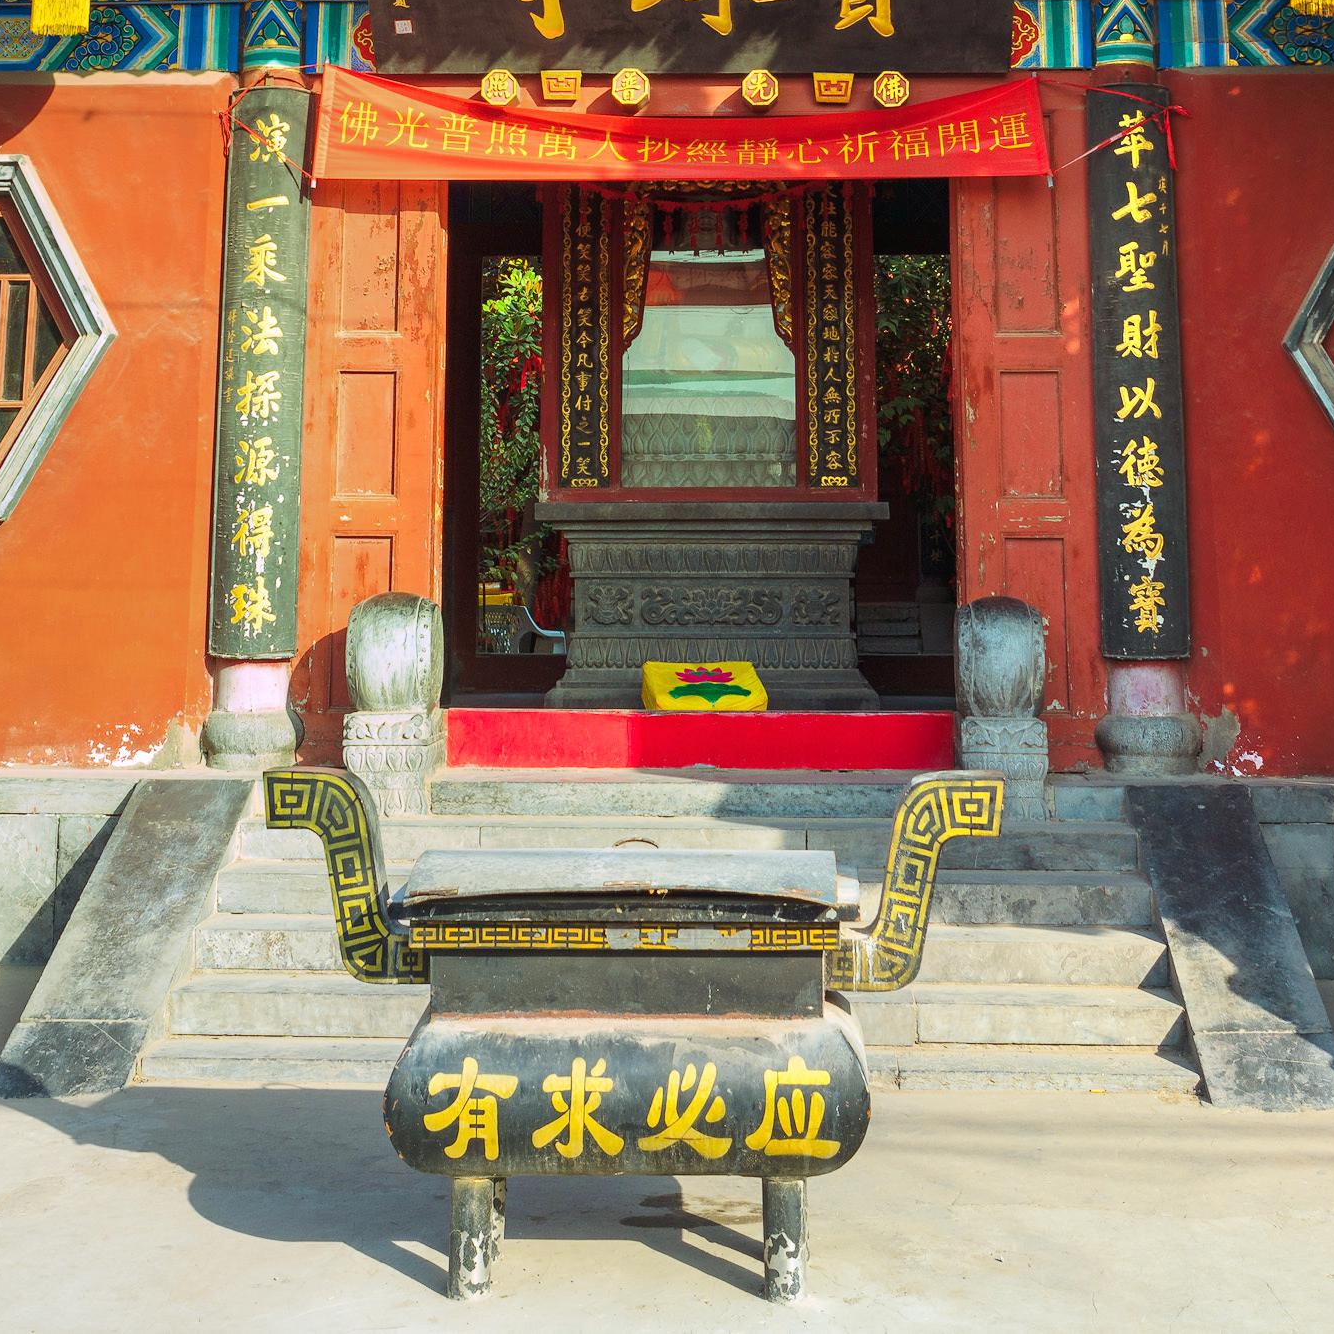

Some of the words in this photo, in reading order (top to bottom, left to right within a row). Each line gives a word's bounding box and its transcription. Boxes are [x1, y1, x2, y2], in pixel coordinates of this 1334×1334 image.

[338, 100, 1034, 167] 佛光普照萬人抄經靜心祈福開運
[423, 1055, 842, 1159] 有求必应
